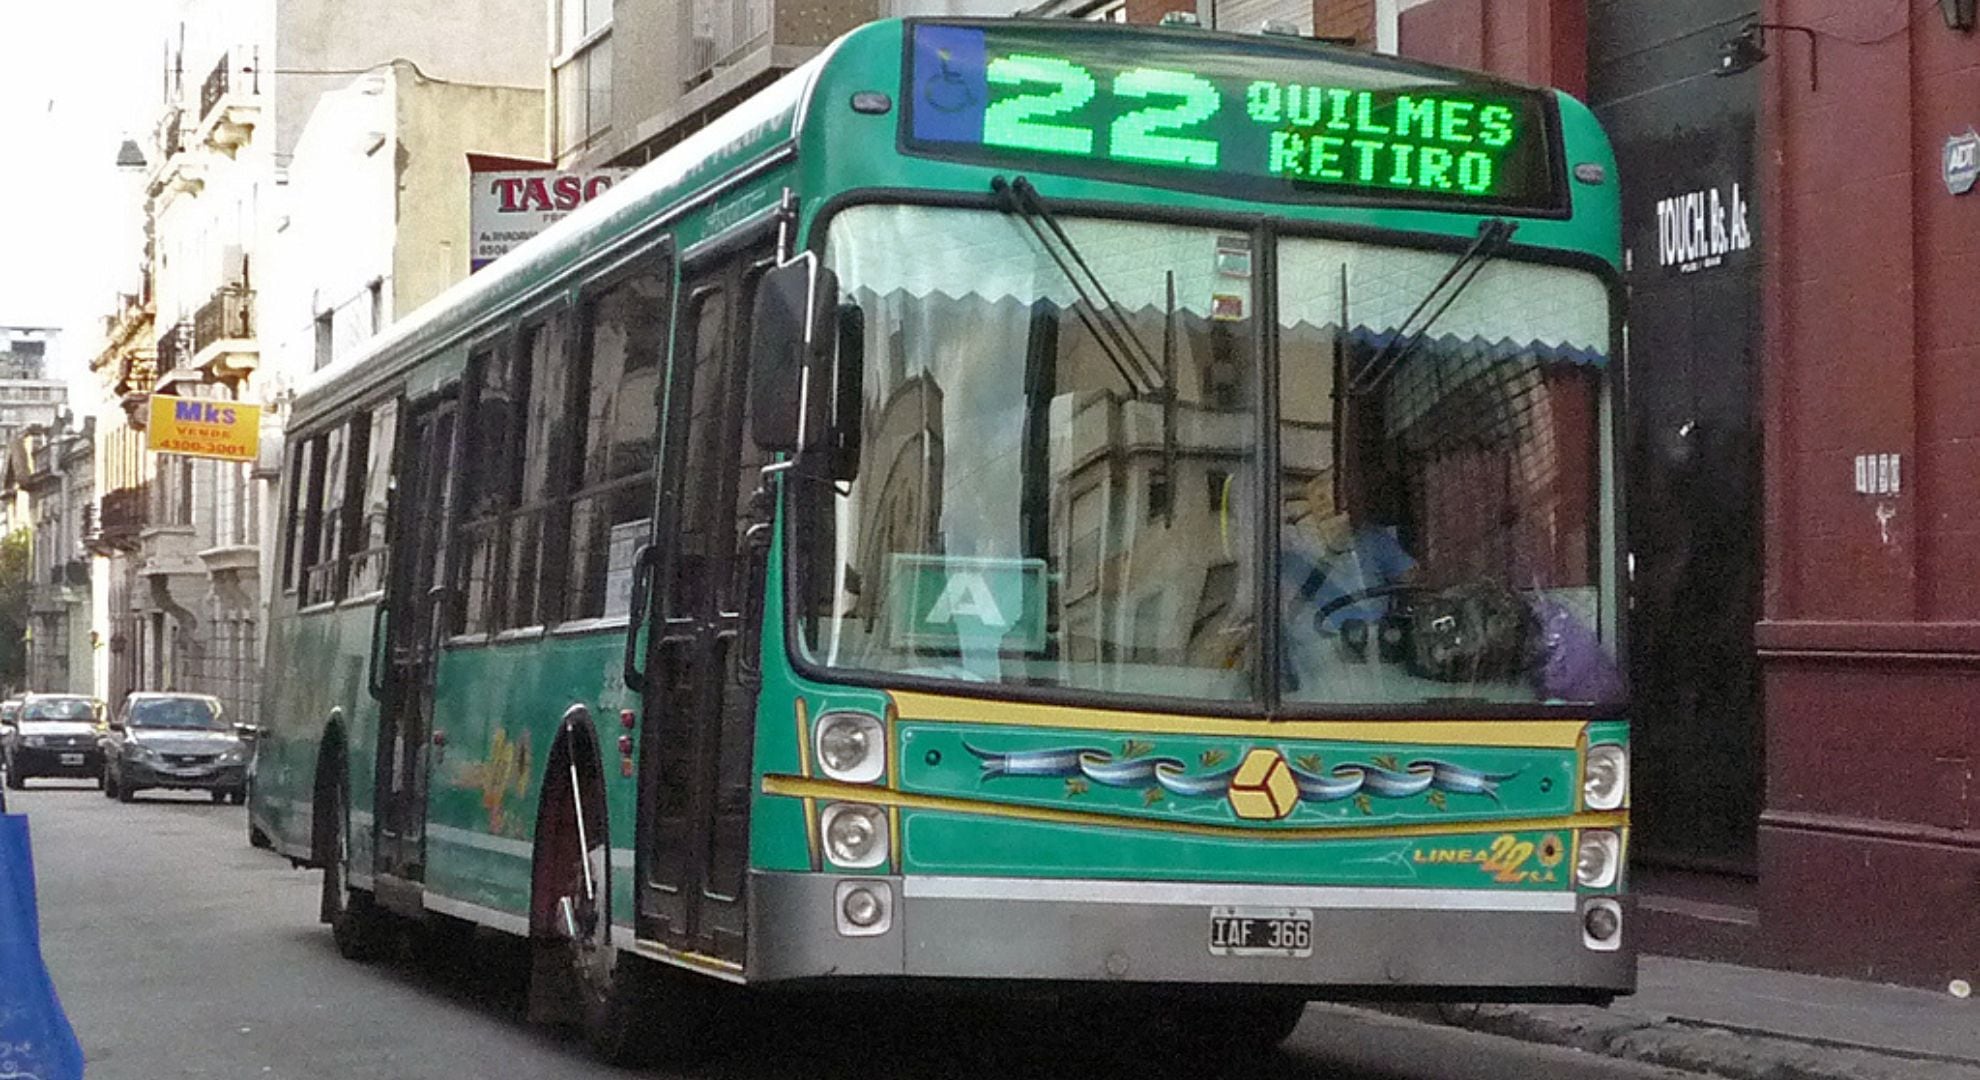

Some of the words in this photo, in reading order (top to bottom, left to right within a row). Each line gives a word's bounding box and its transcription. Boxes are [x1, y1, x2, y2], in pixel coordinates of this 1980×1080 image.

[983, 54, 1220, 166] 22
[1247, 81, 1513, 146] QUILMES
[1269, 132, 1492, 192] RETIRO
[1949, 143, 1976, 170] ADT
[491, 176, 630, 212] TASC
[176, 401, 236, 424] Mks
[176, 427, 231, 439] VENDE
[925, 572, 1006, 626] A
[1413, 848, 1489, 863] LINEA
[1481, 833, 1534, 883] 22
[1213, 919, 1254, 946] IAF
[1267, 920, 1309, 948] 366
